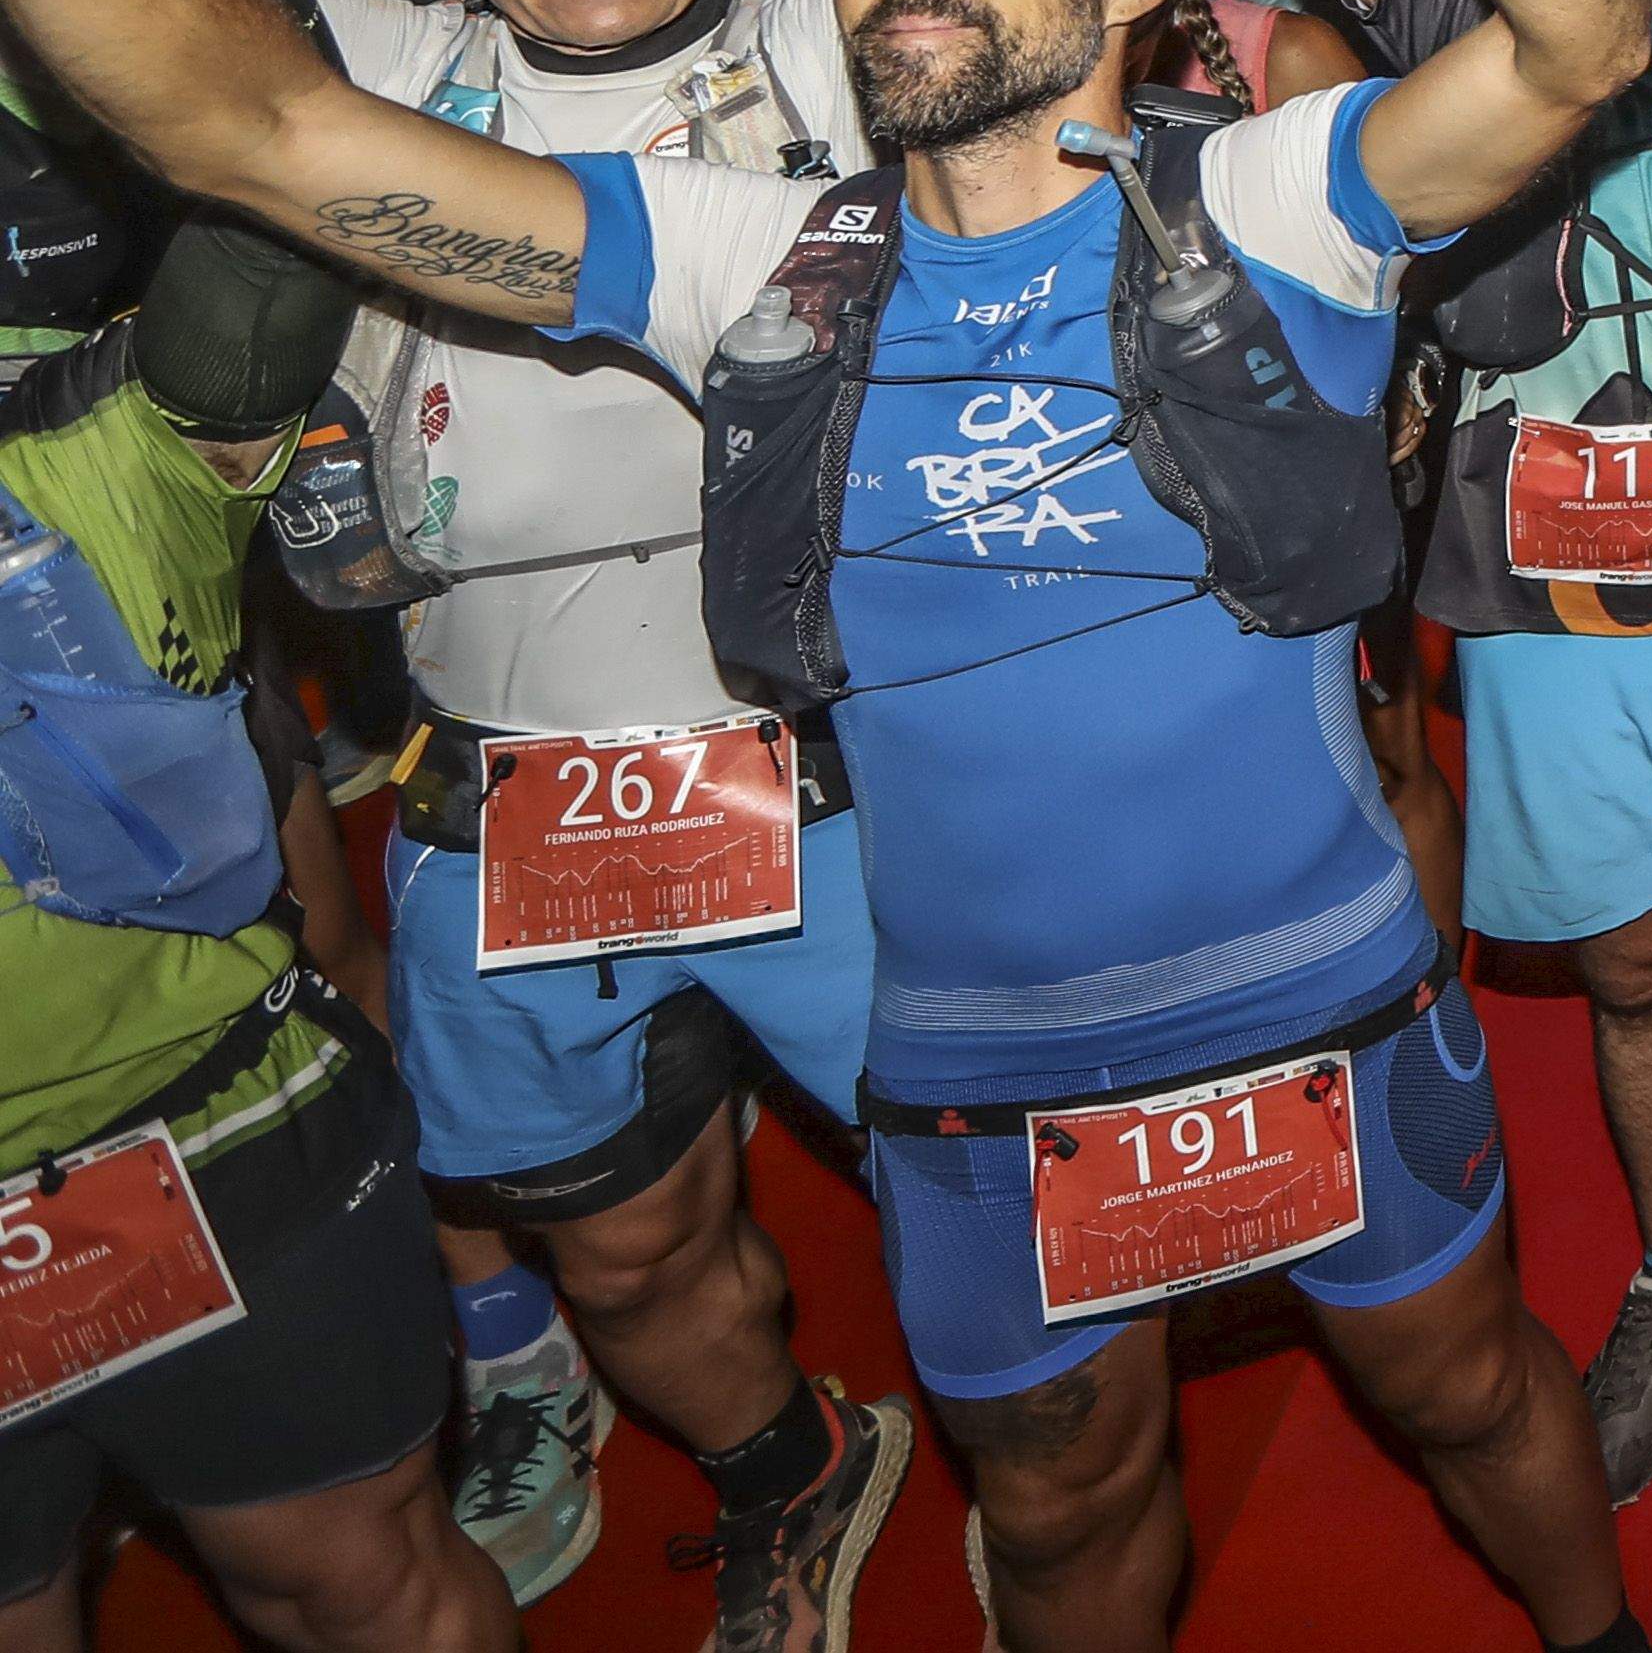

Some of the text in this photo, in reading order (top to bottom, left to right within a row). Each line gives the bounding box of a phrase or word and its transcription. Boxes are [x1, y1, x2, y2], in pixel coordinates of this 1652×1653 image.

[990, 342, 1034, 368] 21K
[1558, 500, 1582, 510] JOSE
[1582, 501, 1630, 511] MANUEL
[1003, 568, 1091, 591] TRAIL
[557, 740, 708, 828] 267
[544, 812, 725, 846] FERNANDO RUZA RODRIGUEZ
[1118, 1096, 1263, 1186] 191
[1100, 1150, 1294, 1211] JORGE MARTINEZ HERNANDEZ
